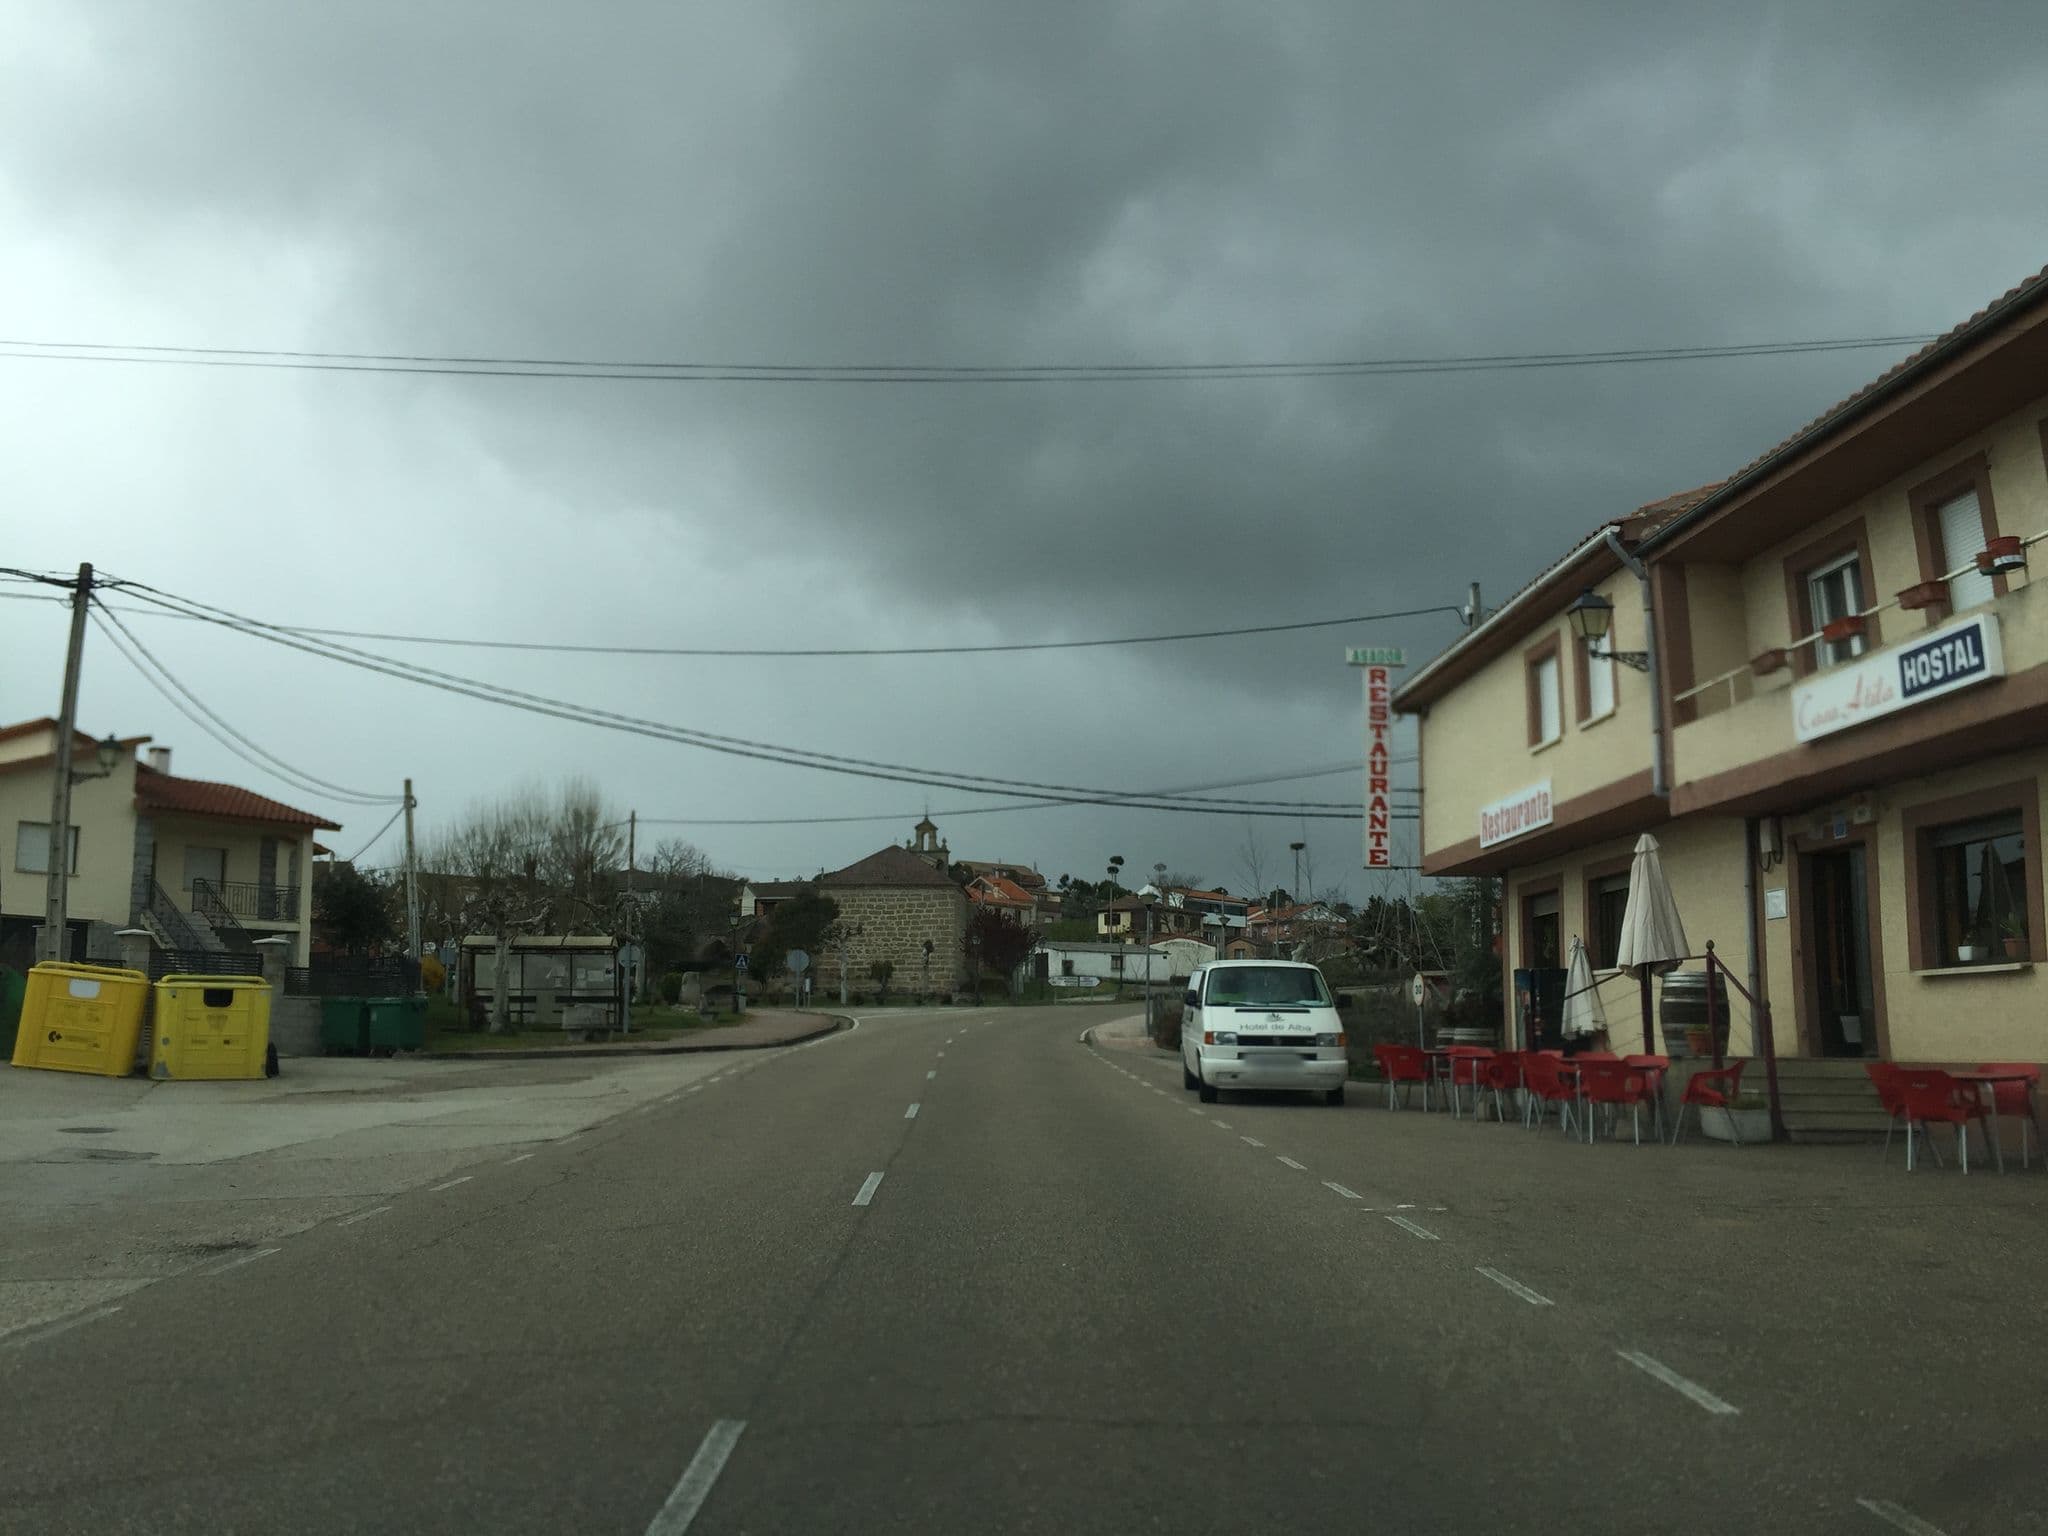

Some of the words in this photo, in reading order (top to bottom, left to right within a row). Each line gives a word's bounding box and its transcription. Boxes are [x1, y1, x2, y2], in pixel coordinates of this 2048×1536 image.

[1903, 635, 1980, 690] HOSTAL
[1369, 669, 1388, 866] RESTAURANTE
[1482, 790, 1549, 843] Restaurante
[1288, 1024, 1312, 1032] Alba
